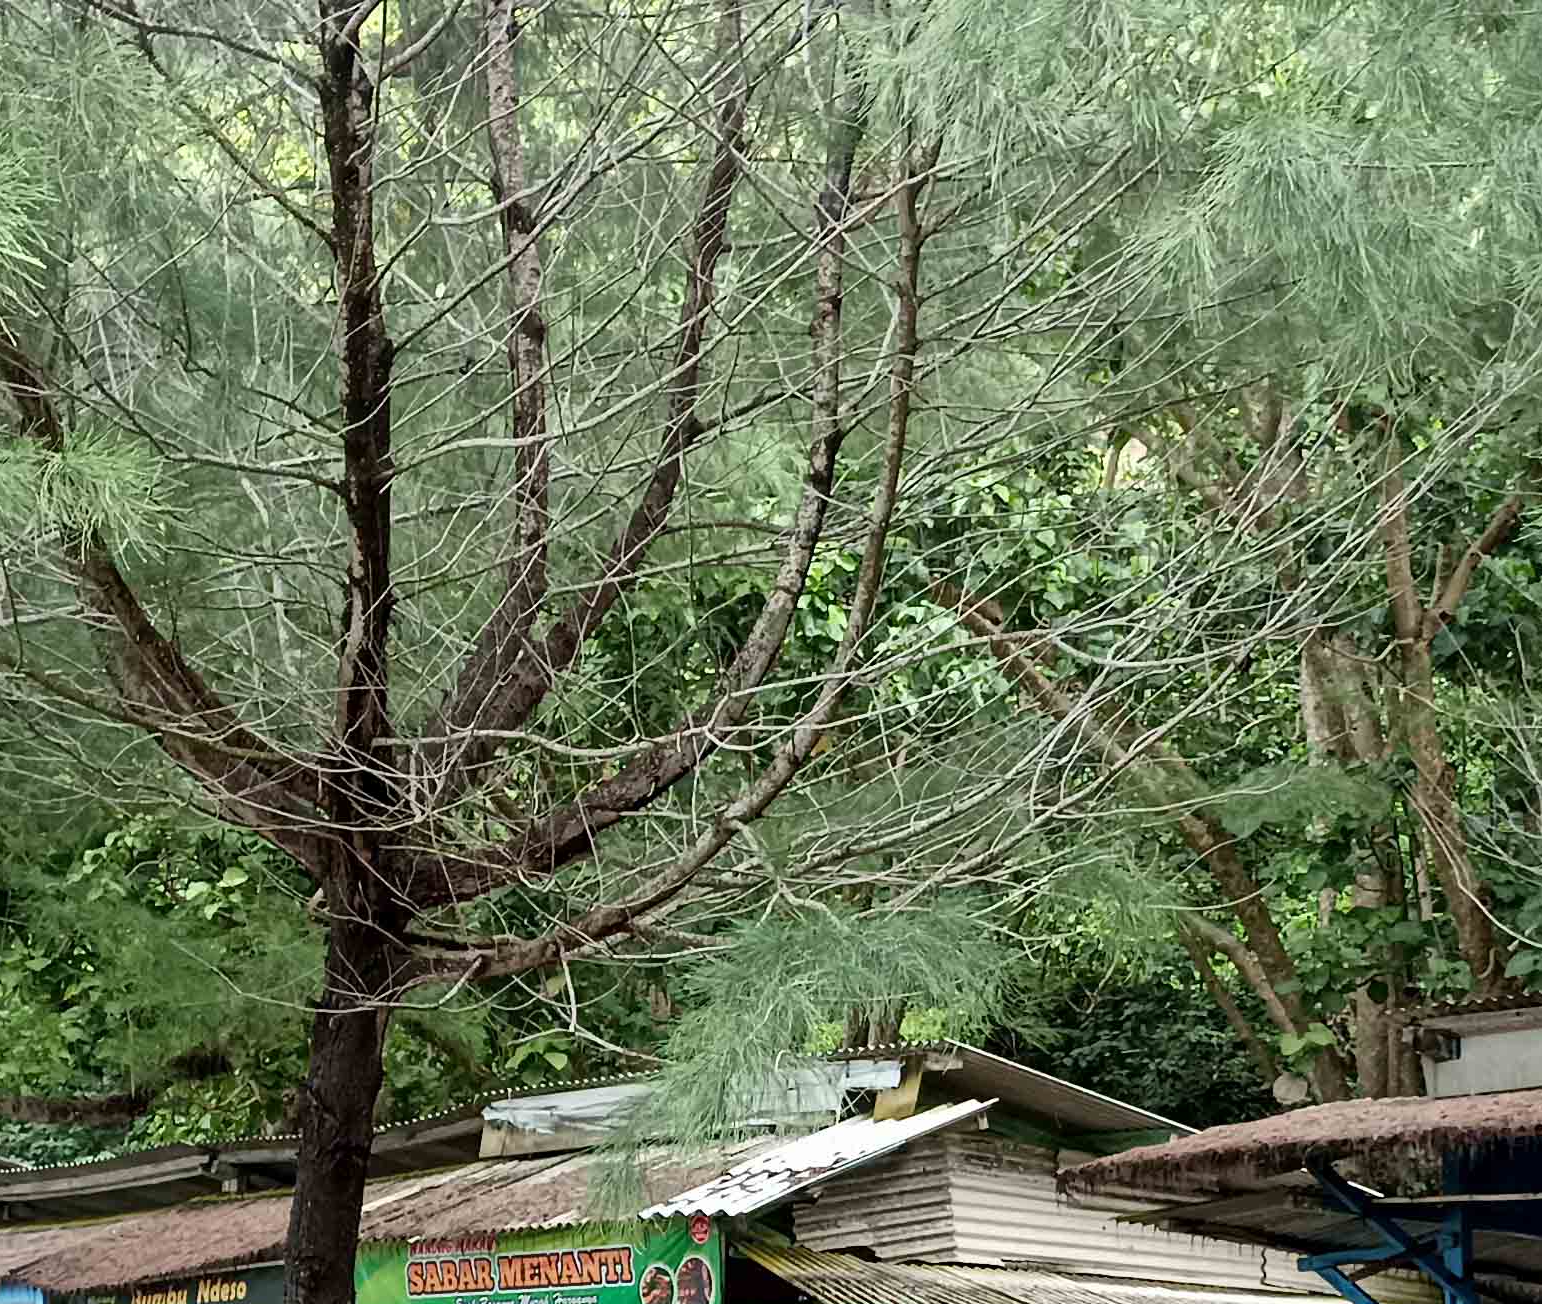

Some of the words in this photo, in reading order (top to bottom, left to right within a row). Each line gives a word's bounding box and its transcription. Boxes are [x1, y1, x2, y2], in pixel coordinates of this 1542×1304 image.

[408, 1258, 496, 1295] SABAR
[497, 1248, 633, 1290] MENANTI
[197, 1279, 248, 1304] Ndeso
